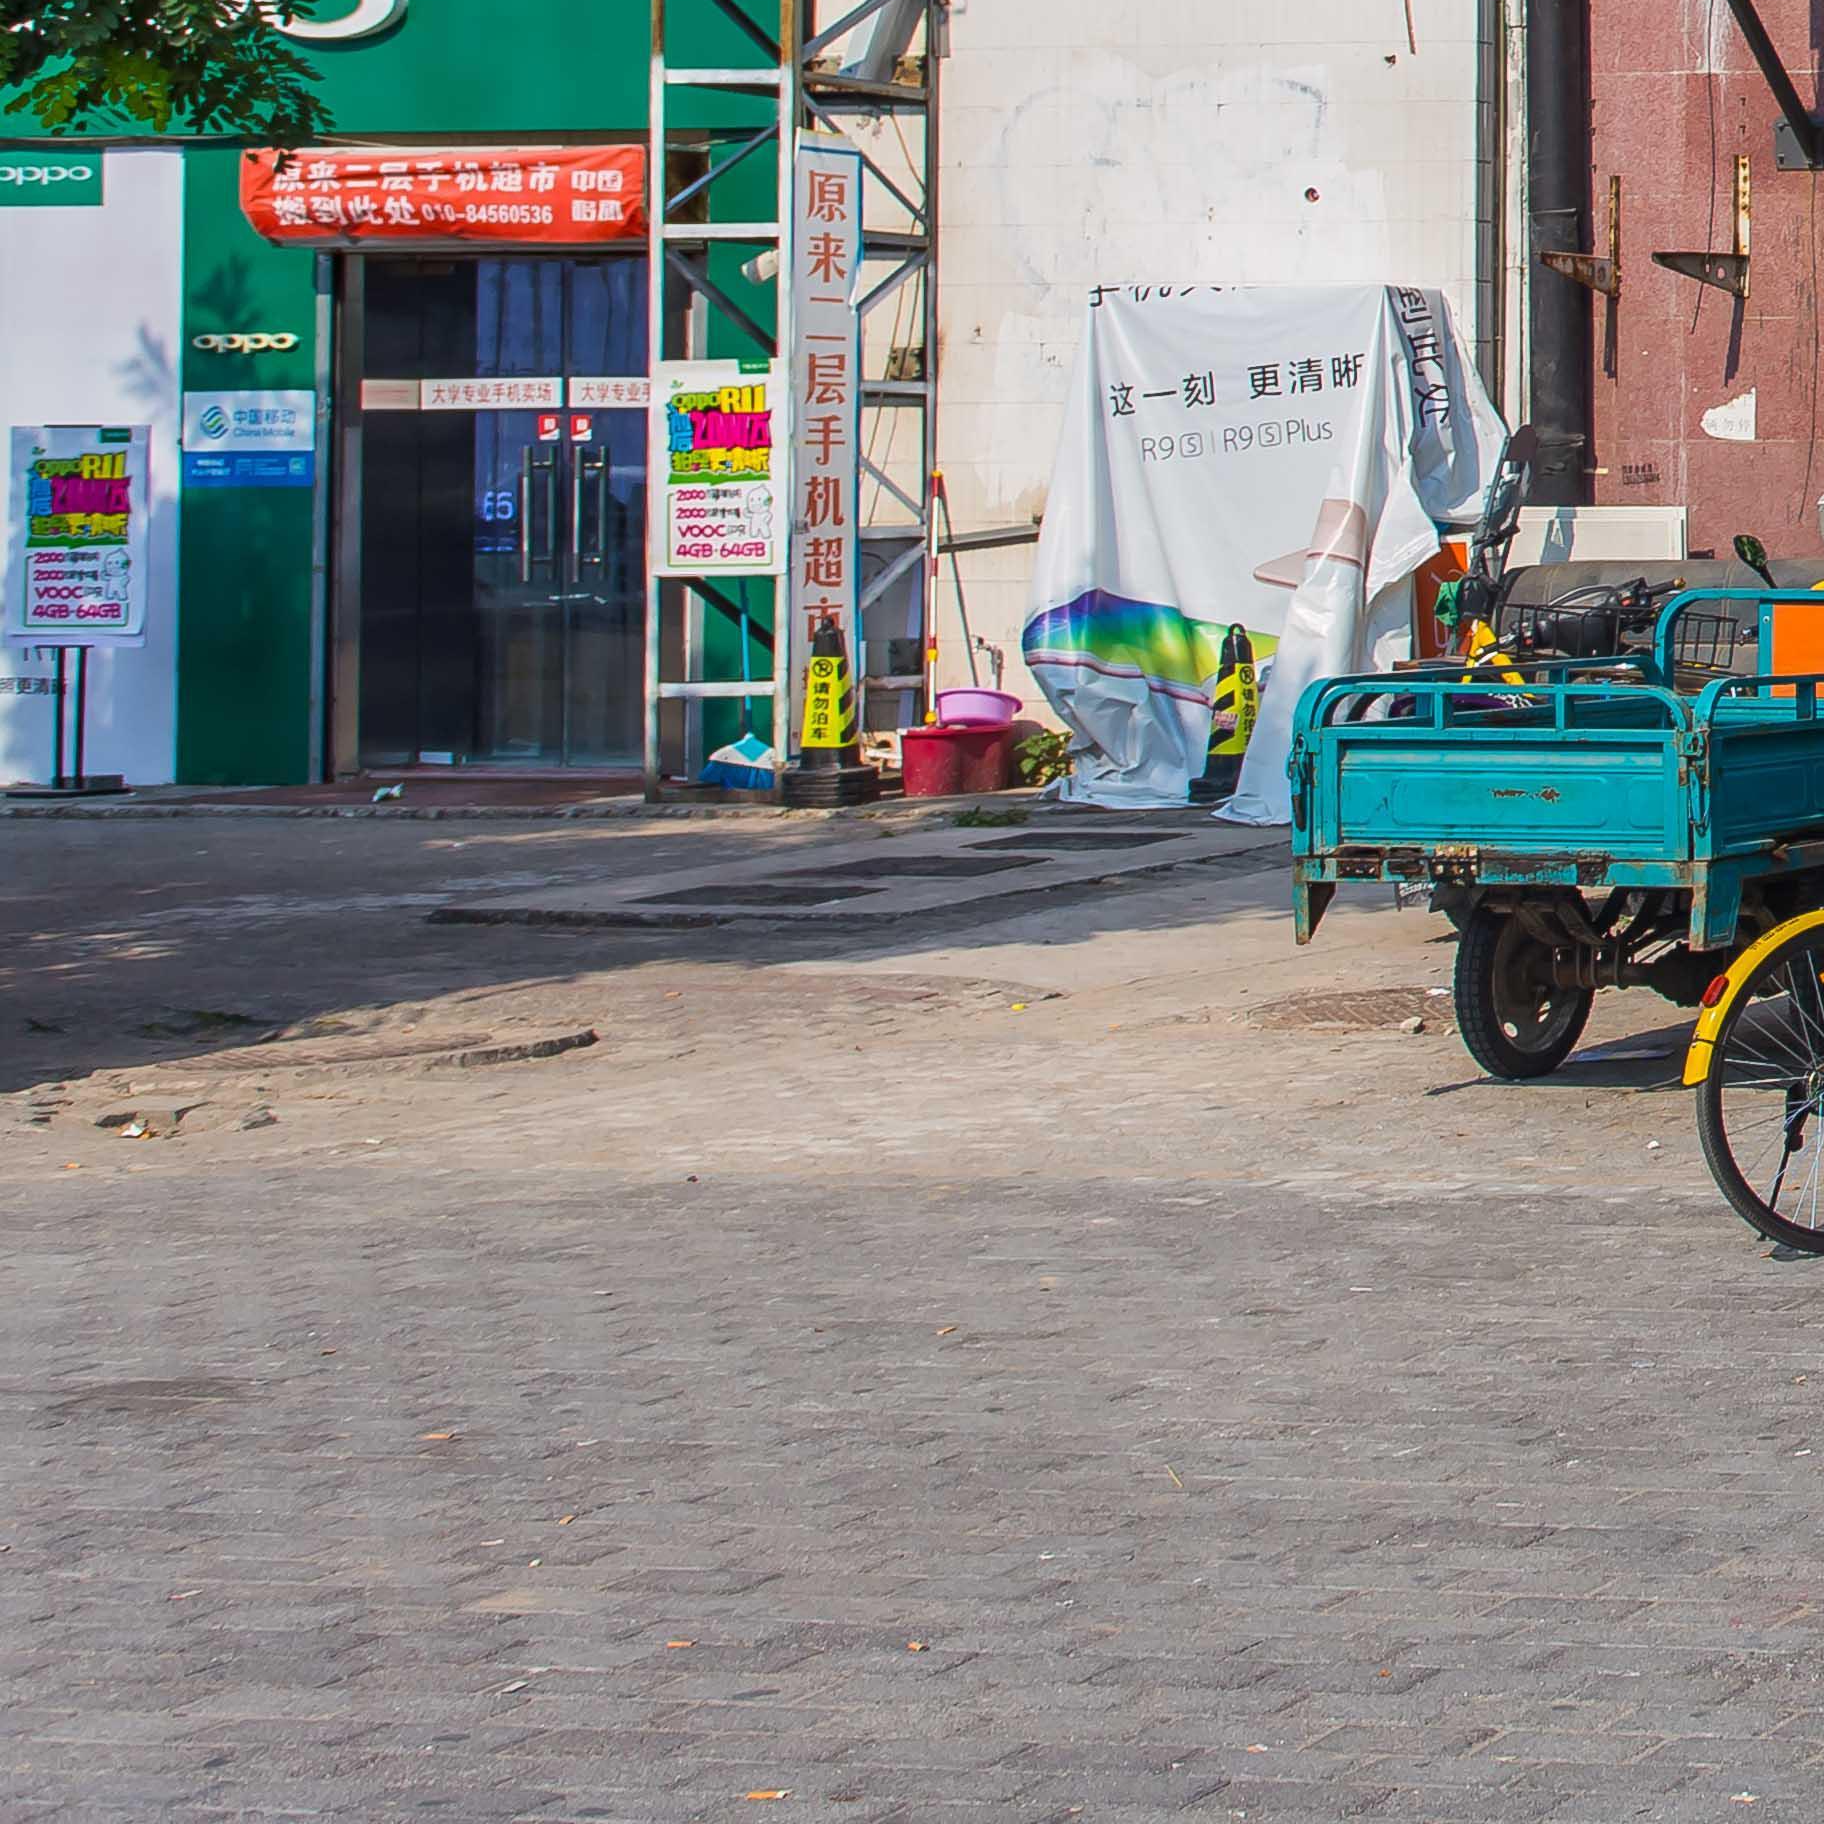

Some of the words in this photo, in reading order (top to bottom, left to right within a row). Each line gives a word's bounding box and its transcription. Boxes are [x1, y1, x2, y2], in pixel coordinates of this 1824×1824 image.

[273, 161, 560, 193] 原来二层手机超市
[1108, 369, 1216, 418] 这一刻
[1246, 352, 1366, 401] 更清晰
[1286, 416, 1335, 446] Plus
[811, 680, 833, 743] 请勿泊车
